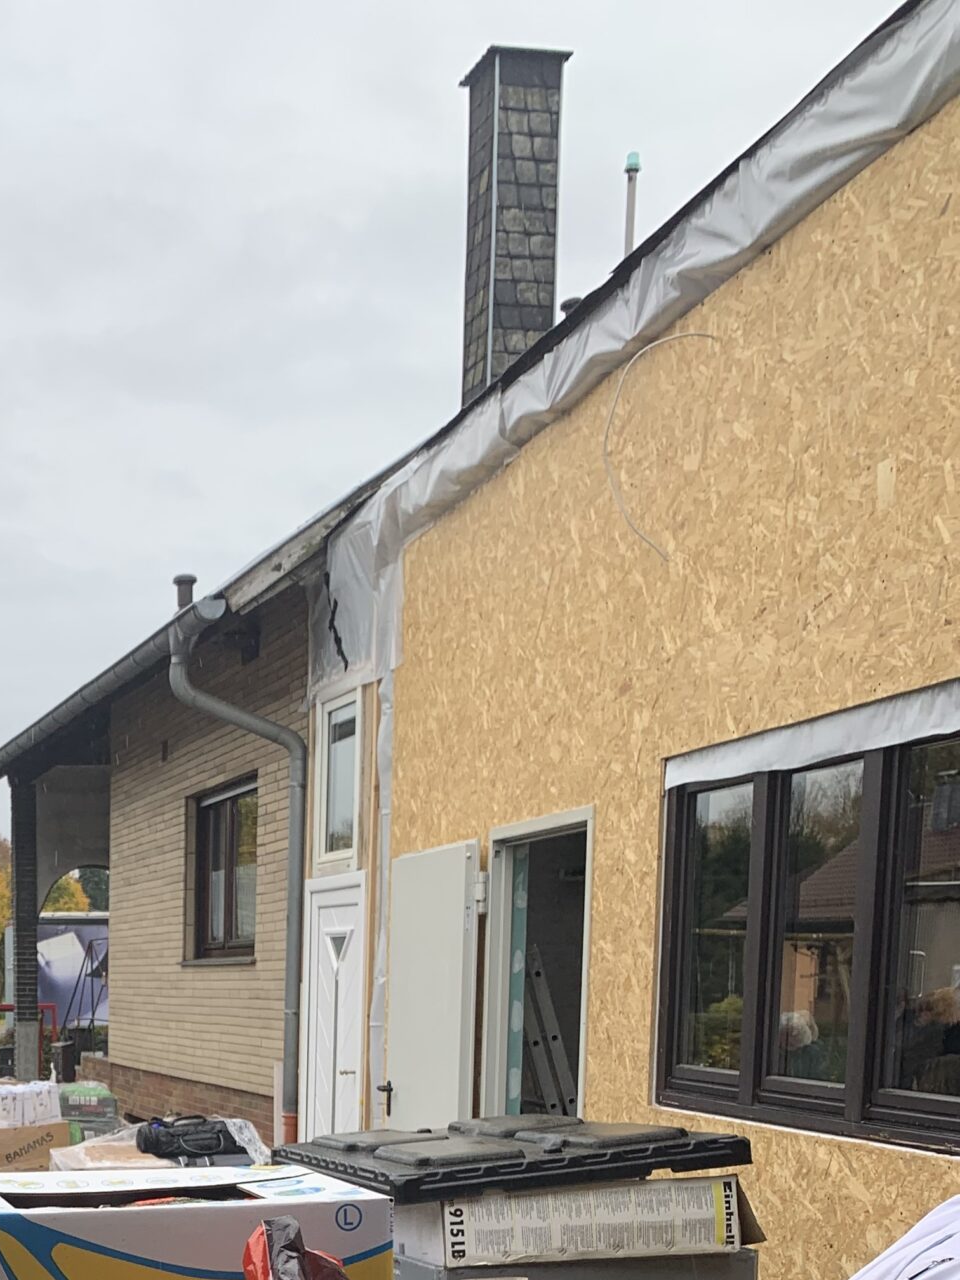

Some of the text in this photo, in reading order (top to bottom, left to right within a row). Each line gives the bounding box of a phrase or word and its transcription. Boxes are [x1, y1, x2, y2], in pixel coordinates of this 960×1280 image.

[449, 1208, 464, 1238] 915
[720, 1181, 737, 1246] Einhell
[450, 1241, 466, 1260] LB
